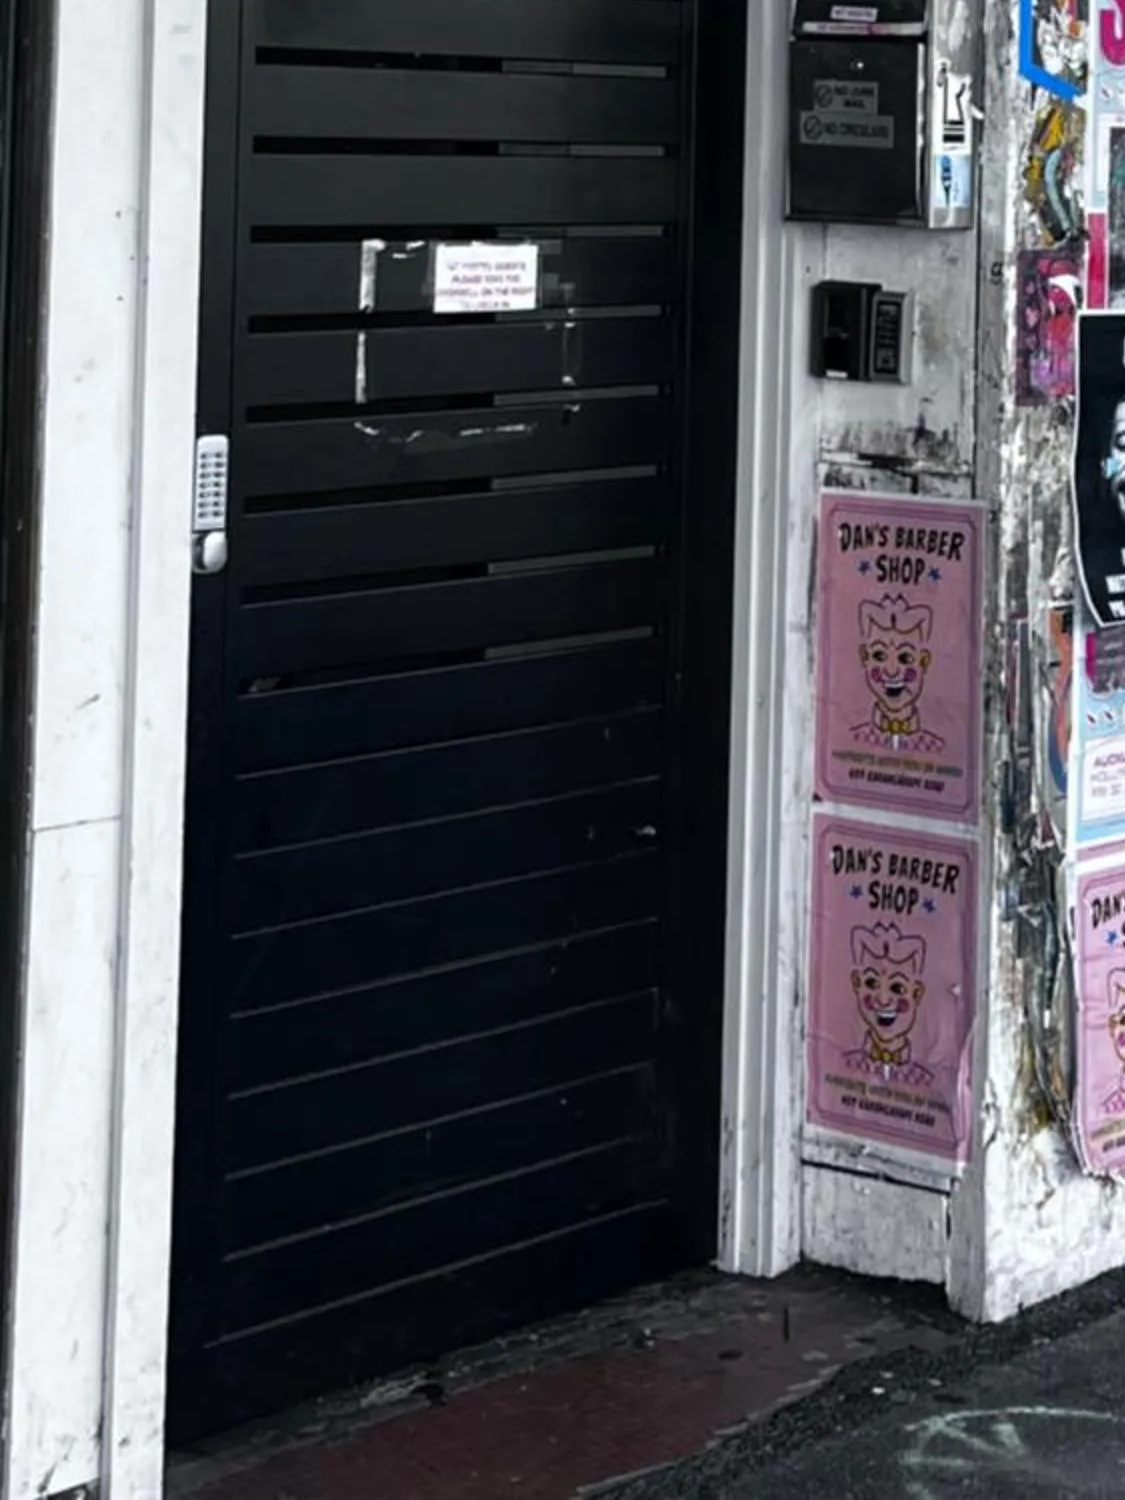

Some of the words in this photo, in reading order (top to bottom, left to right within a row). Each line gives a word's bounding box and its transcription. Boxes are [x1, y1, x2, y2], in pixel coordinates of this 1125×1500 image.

[839, 523, 891, 551] DAN'S
[895, 530, 965, 561] BARBER
[876, 555, 925, 584] SHOP
[832, 845, 883, 876] DAN'S
[888, 852, 961, 895] BARBER
[868, 880, 919, 915] SHOP
